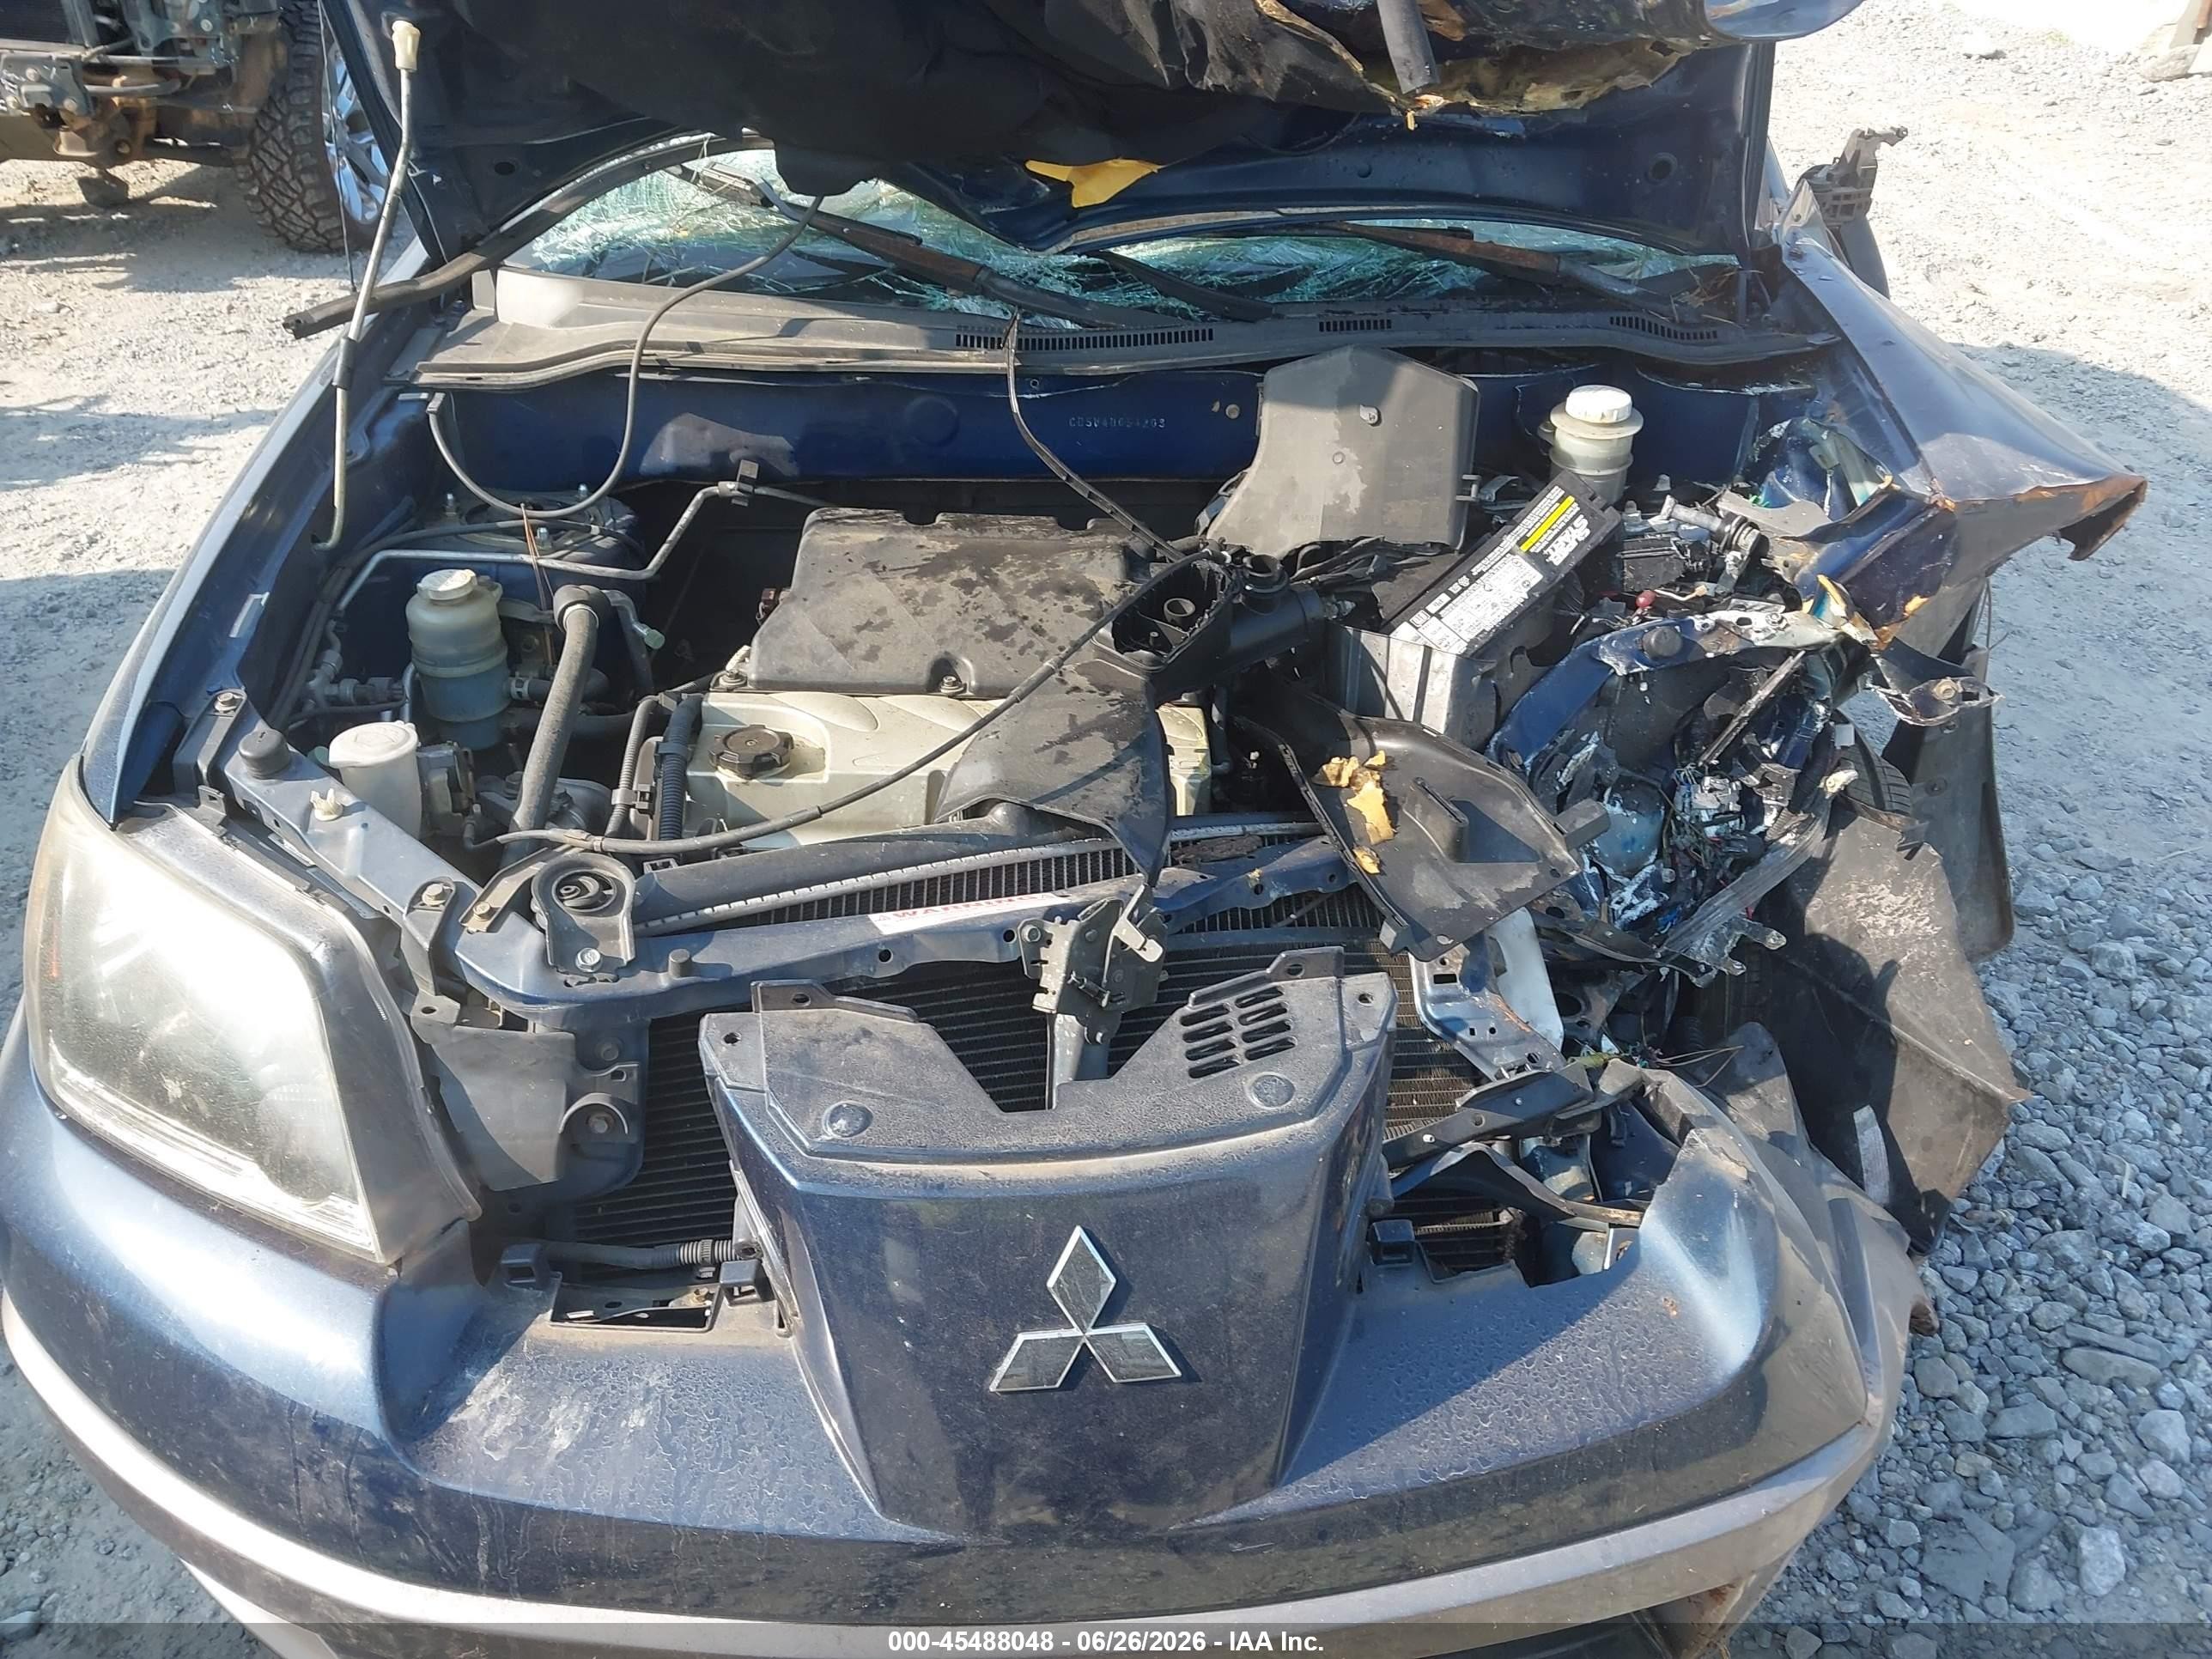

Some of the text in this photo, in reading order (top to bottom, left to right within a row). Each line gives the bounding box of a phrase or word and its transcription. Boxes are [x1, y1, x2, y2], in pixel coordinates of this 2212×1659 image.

[1544, 514, 1589, 559] START
[1550, 526, 1590, 566] SUPER
[893, 896, 1037, 918] WARNING
